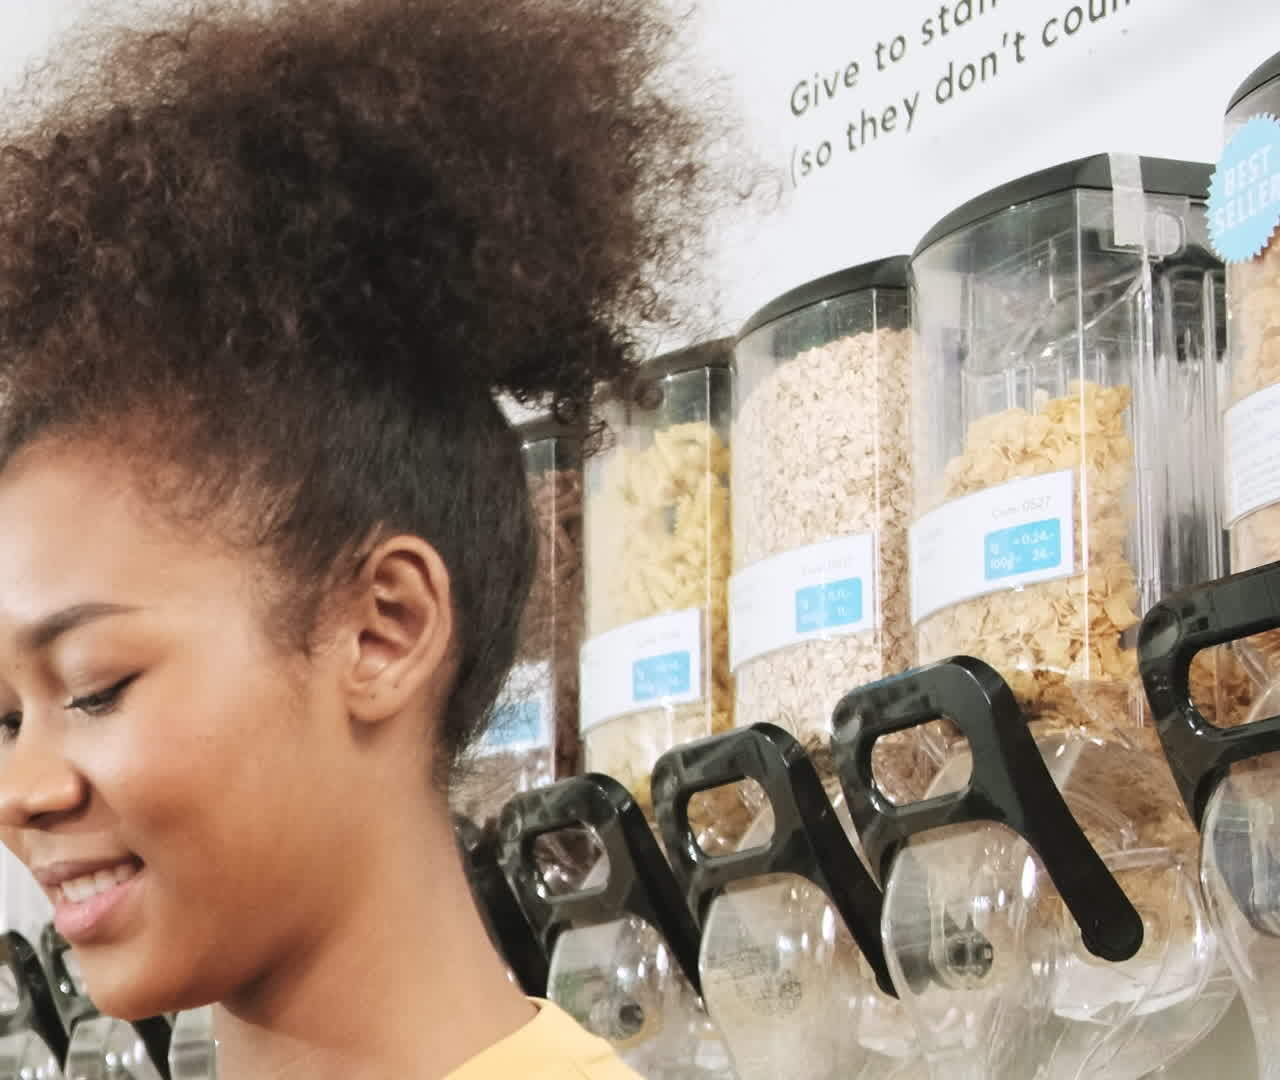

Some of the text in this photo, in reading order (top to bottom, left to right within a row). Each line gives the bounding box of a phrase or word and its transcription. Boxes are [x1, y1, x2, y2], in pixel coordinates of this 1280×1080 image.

[790, 61, 860, 116] Give
[874, 35, 906, 71] to
[790, 140, 832, 188] (so
[846, 91, 920, 152] they
[935, 31, 1026, 105] don't
[1224, 144, 1272, 197] BEST
